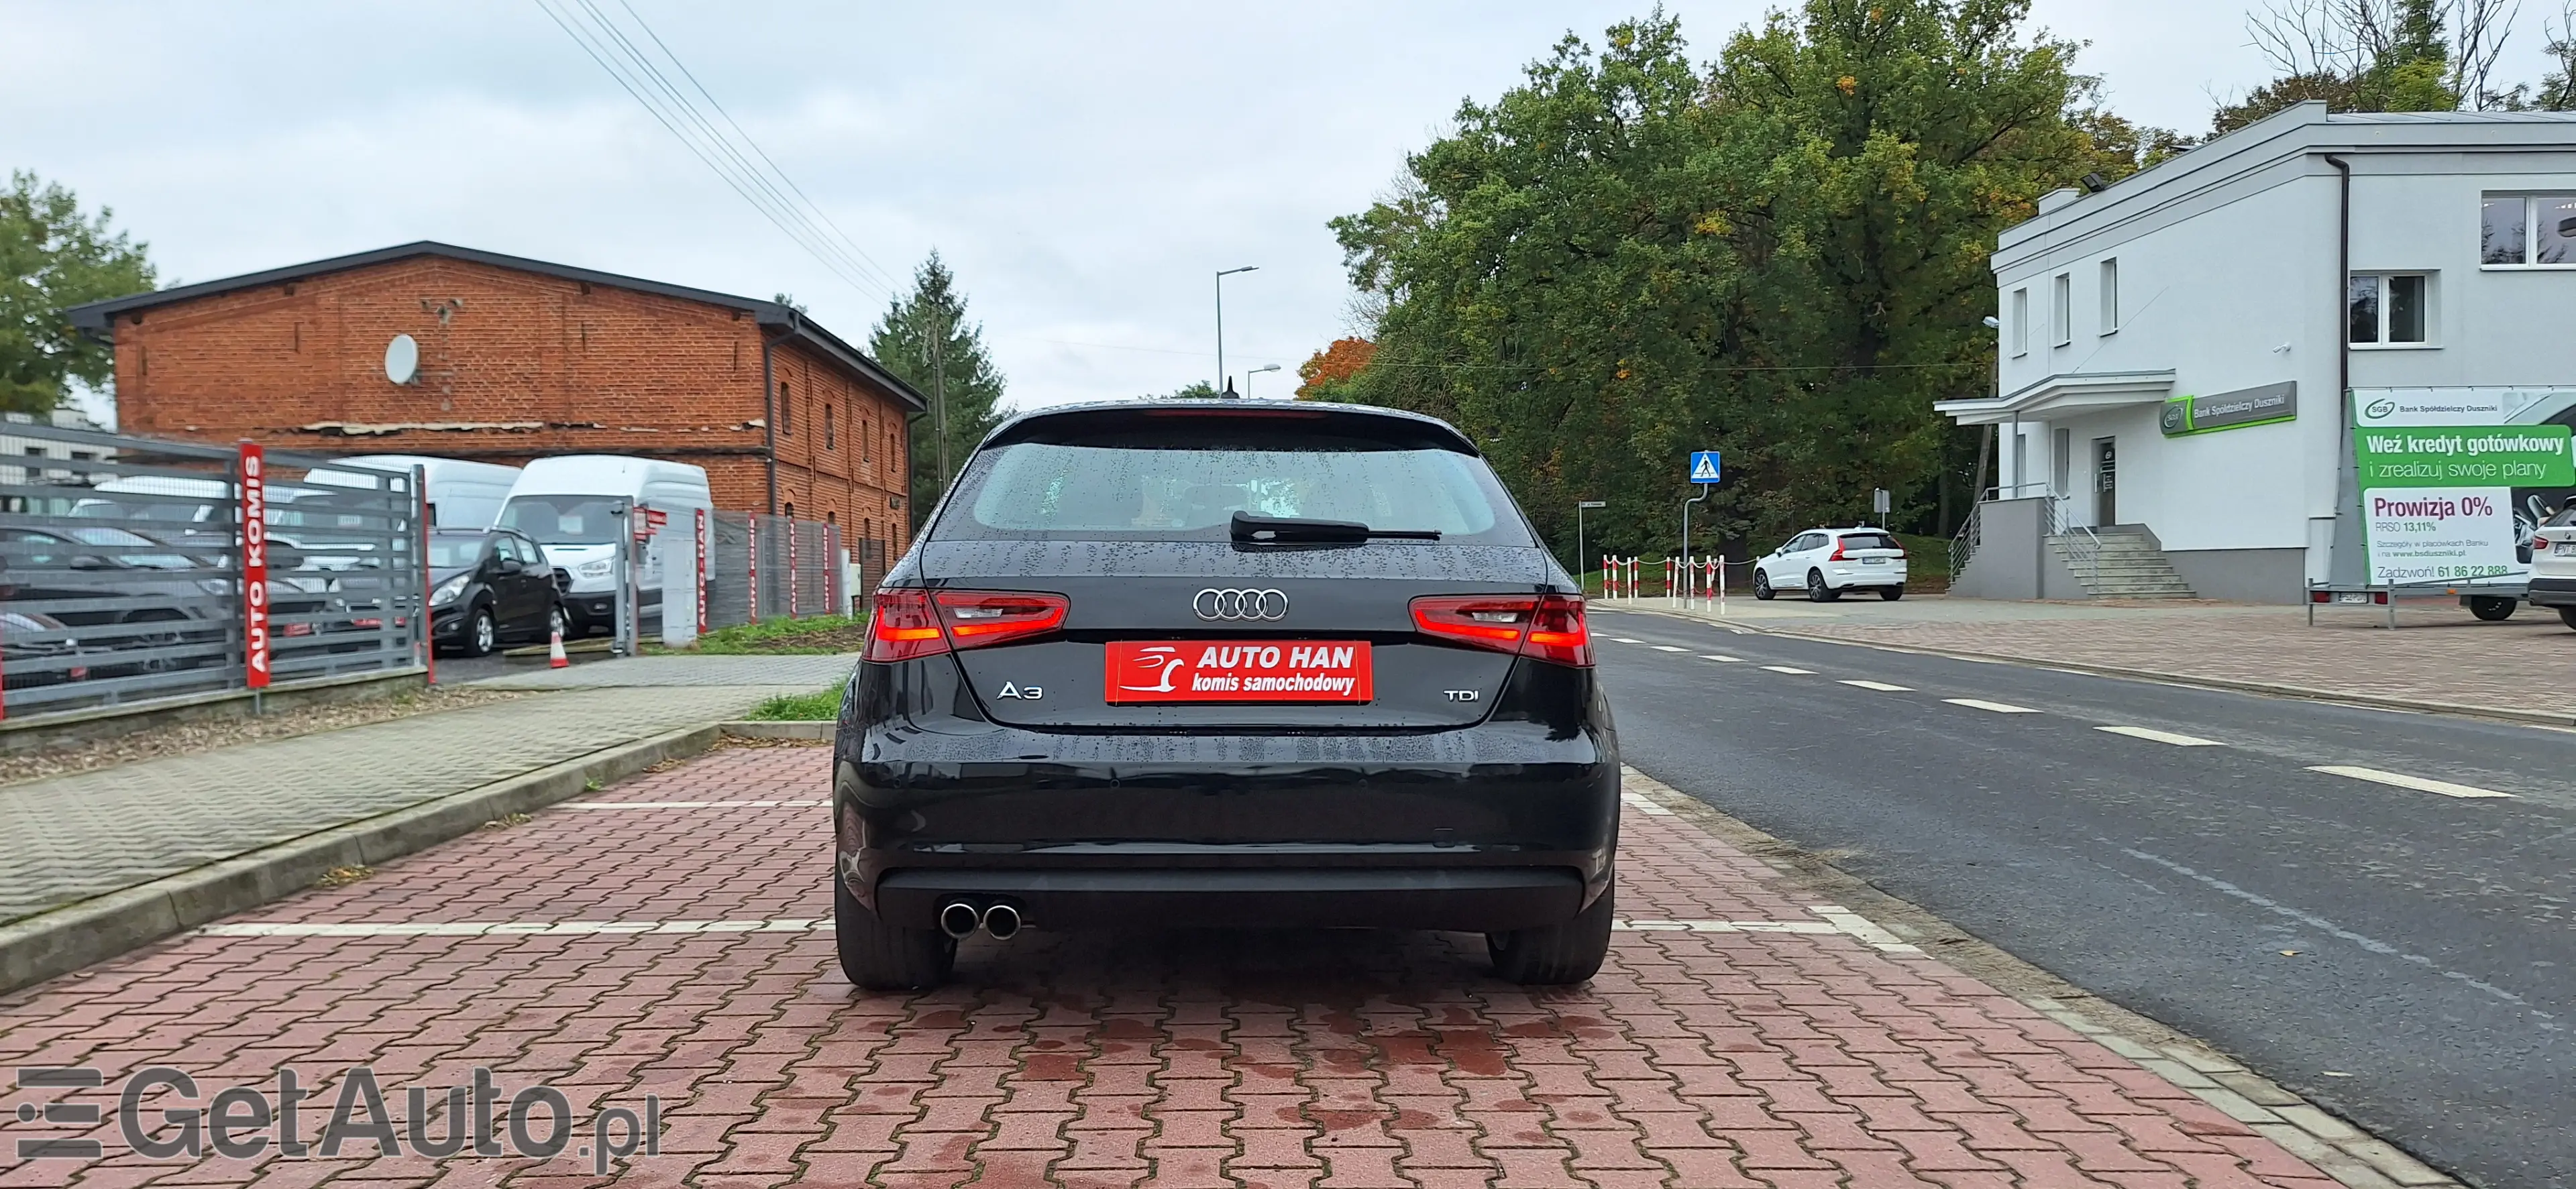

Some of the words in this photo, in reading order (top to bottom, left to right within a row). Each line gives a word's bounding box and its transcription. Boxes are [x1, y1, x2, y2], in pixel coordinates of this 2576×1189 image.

[2194, 407, 2211, 418] Bank
[2212, 400, 2253, 418] Spółdzielczy
[2254, 394, 2285, 409] Duszniki
[2371, 405, 2388, 413] SGB
[2420, 404, 2465, 414] Spółdzielczy
[2366, 434, 2402, 454] Weź
[2407, 435, 2463, 456] kredyt
[2467, 433, 2565, 455] gotówkowy
[2369, 461, 2373, 477] i
[2379, 461, 2442, 480] zrealizuj
[2448, 461, 2497, 480] swoje
[2502, 461, 2546, 479] plany
[245, 455, 263, 567] KOMIS
[2373, 497, 2456, 520] Prowizja
[2461, 496, 2493, 517] 0%
[2375, 522, 2400, 532] RRSO
[2404, 522, 2436, 532] 13,11%
[2377, 566, 2434, 578] Zadzwoń!
[2438, 566, 2451, 577] 61
[2455, 566, 2468, 577] 86
[2471, 565, 2483, 576] 22
[2487, 565, 2508, 575] 888
[249, 580, 266, 673] AUTO
[1196, 646, 1281, 669] AUTO
[1288, 646, 1354, 669] HAN
[996, 681, 1043, 700] A3
[1192, 672, 1239, 692] komis
[1242, 672, 1355, 697] samochodowy
[1443, 689, 1480, 702] TDI
